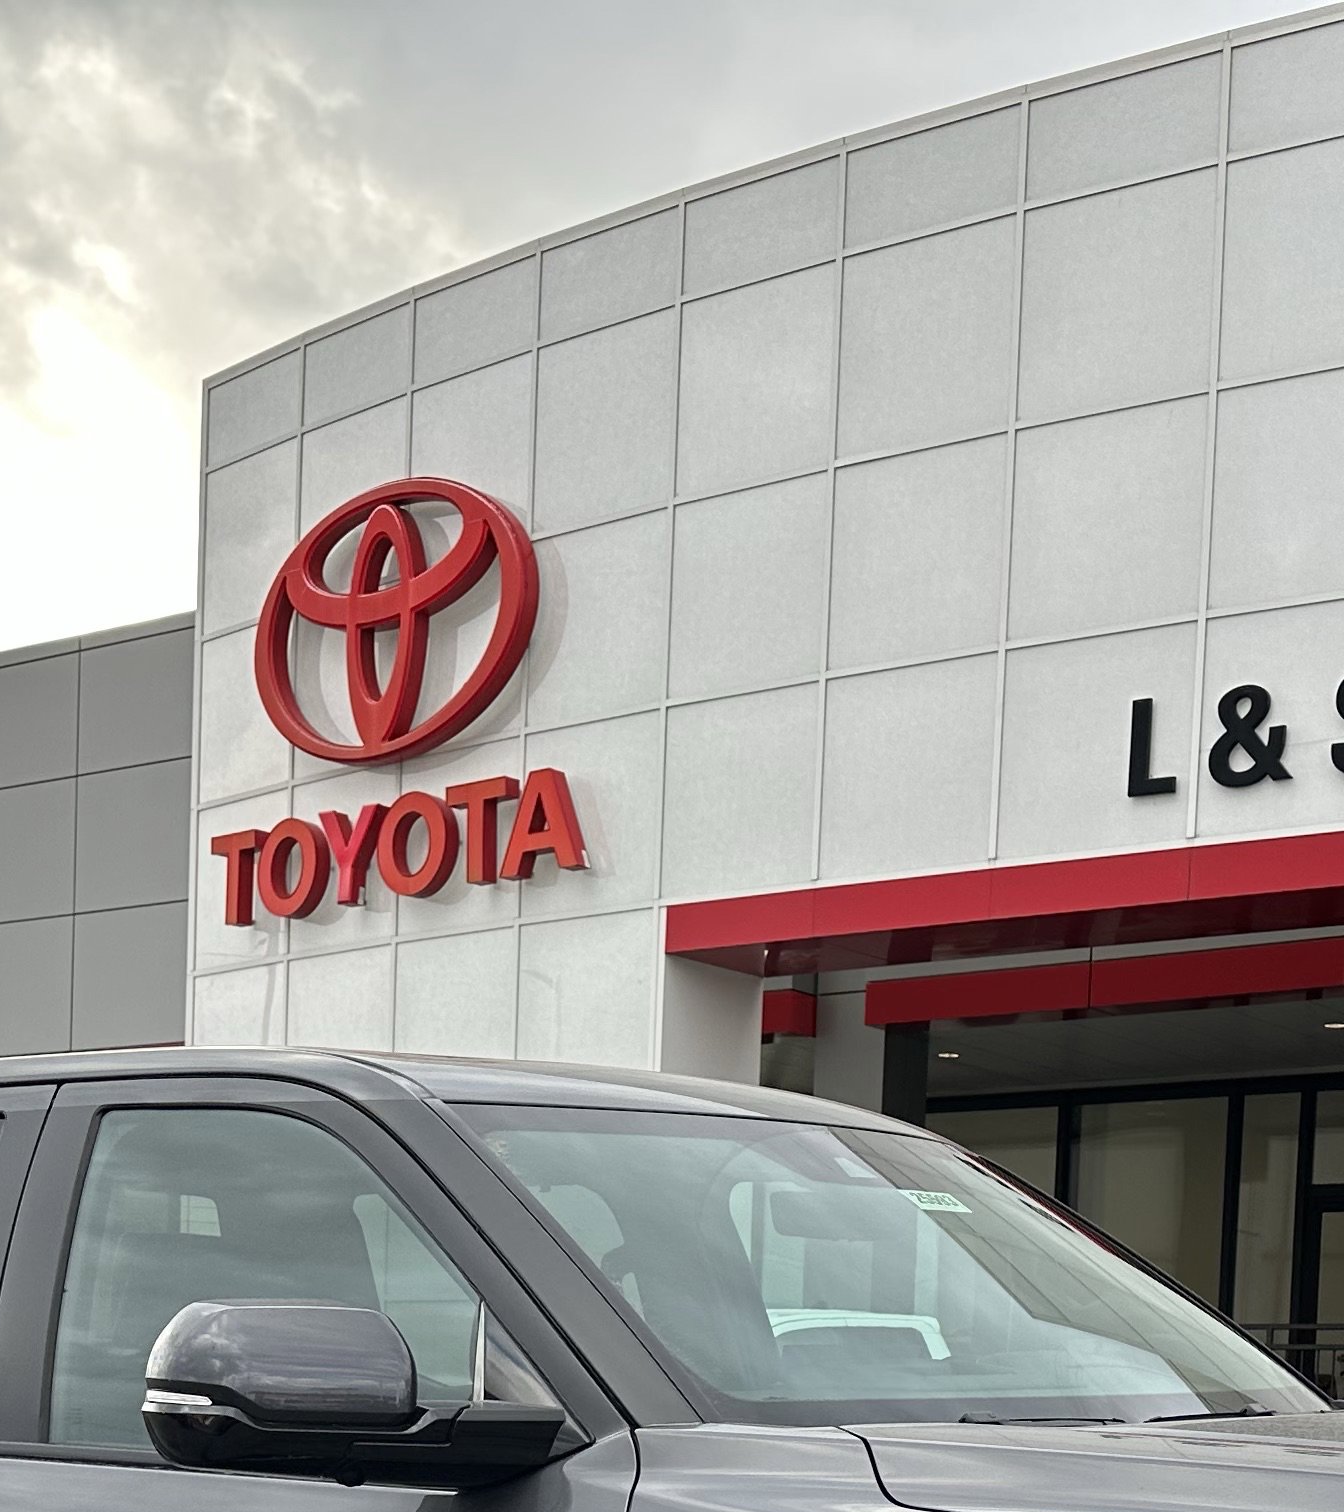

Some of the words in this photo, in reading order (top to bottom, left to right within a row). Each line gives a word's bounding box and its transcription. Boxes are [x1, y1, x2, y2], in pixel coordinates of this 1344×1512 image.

[1128, 698, 1176, 797] L
[1208, 684, 1293, 787] &
[211, 768, 590, 926] TOYOTA
